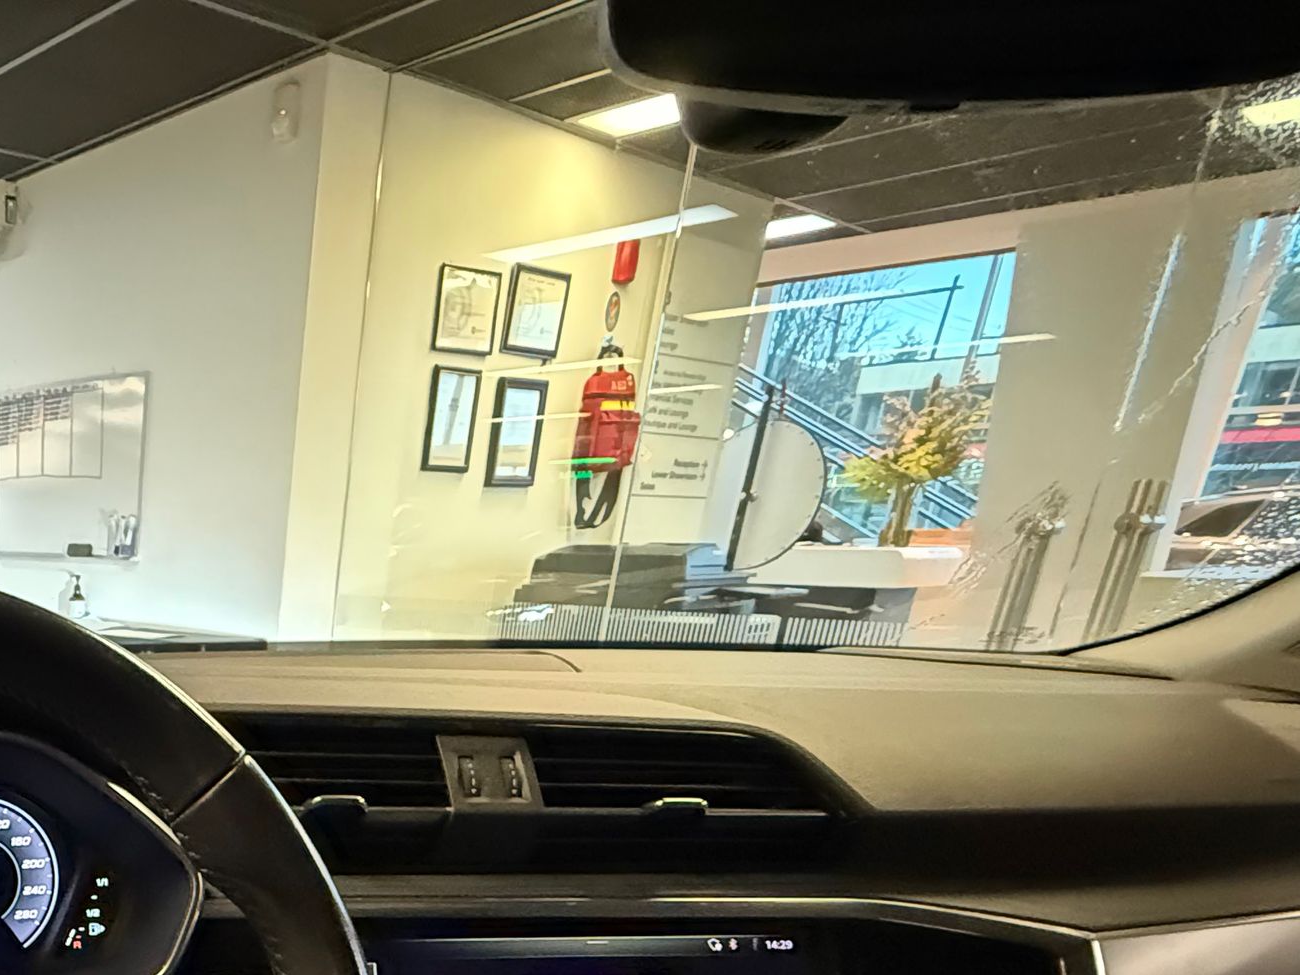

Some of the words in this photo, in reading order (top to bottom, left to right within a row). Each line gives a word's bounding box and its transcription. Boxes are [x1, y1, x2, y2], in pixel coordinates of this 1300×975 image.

[21, 858, 46, 869] 200
[22, 885, 46, 896] 240
[73, 940, 82, 949] R
[765, 939, 794, 950] 14:29
